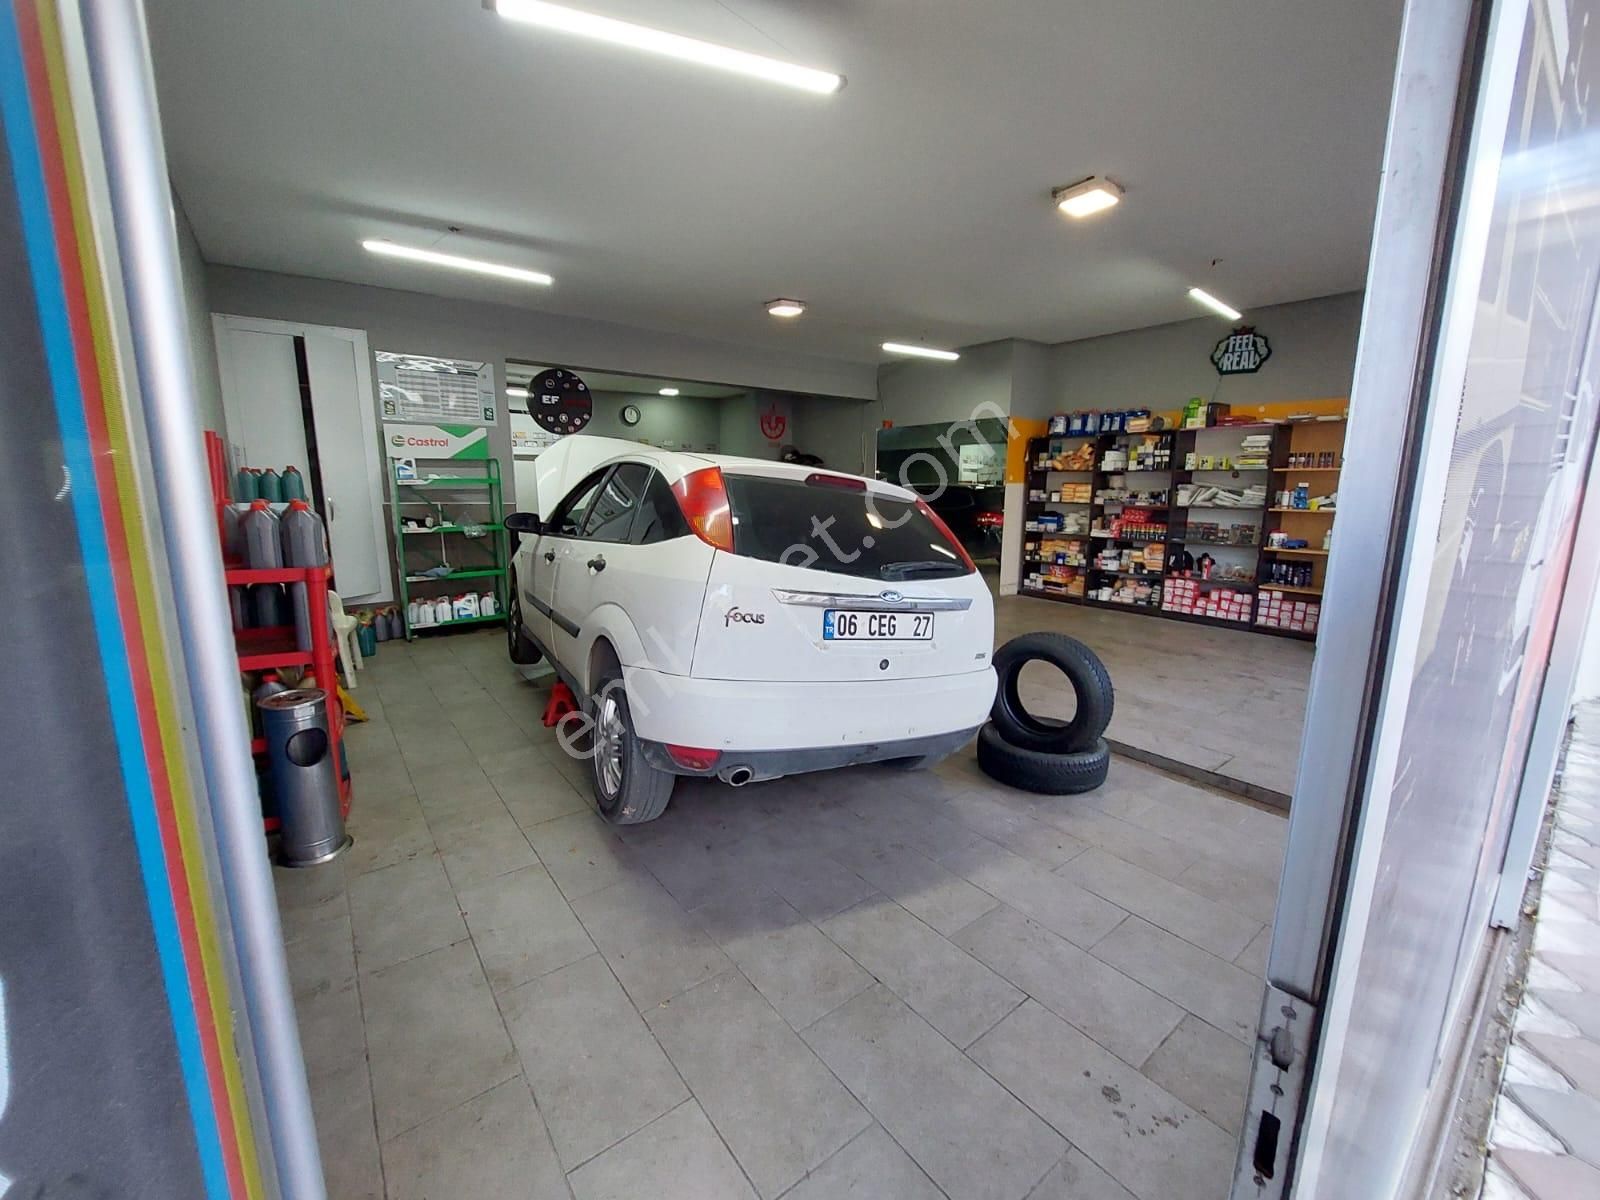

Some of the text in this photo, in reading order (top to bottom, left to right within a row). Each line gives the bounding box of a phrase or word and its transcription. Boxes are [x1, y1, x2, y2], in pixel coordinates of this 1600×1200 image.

[1228, 334, 1254, 352] FEEL
[1222, 350, 1256, 371] REAL
[541, 394, 560, 404] EF
[407, 437, 449, 447] Castrol
[825, 626, 834, 634] TR
[837, 613, 931, 637] 06 CEG 27
